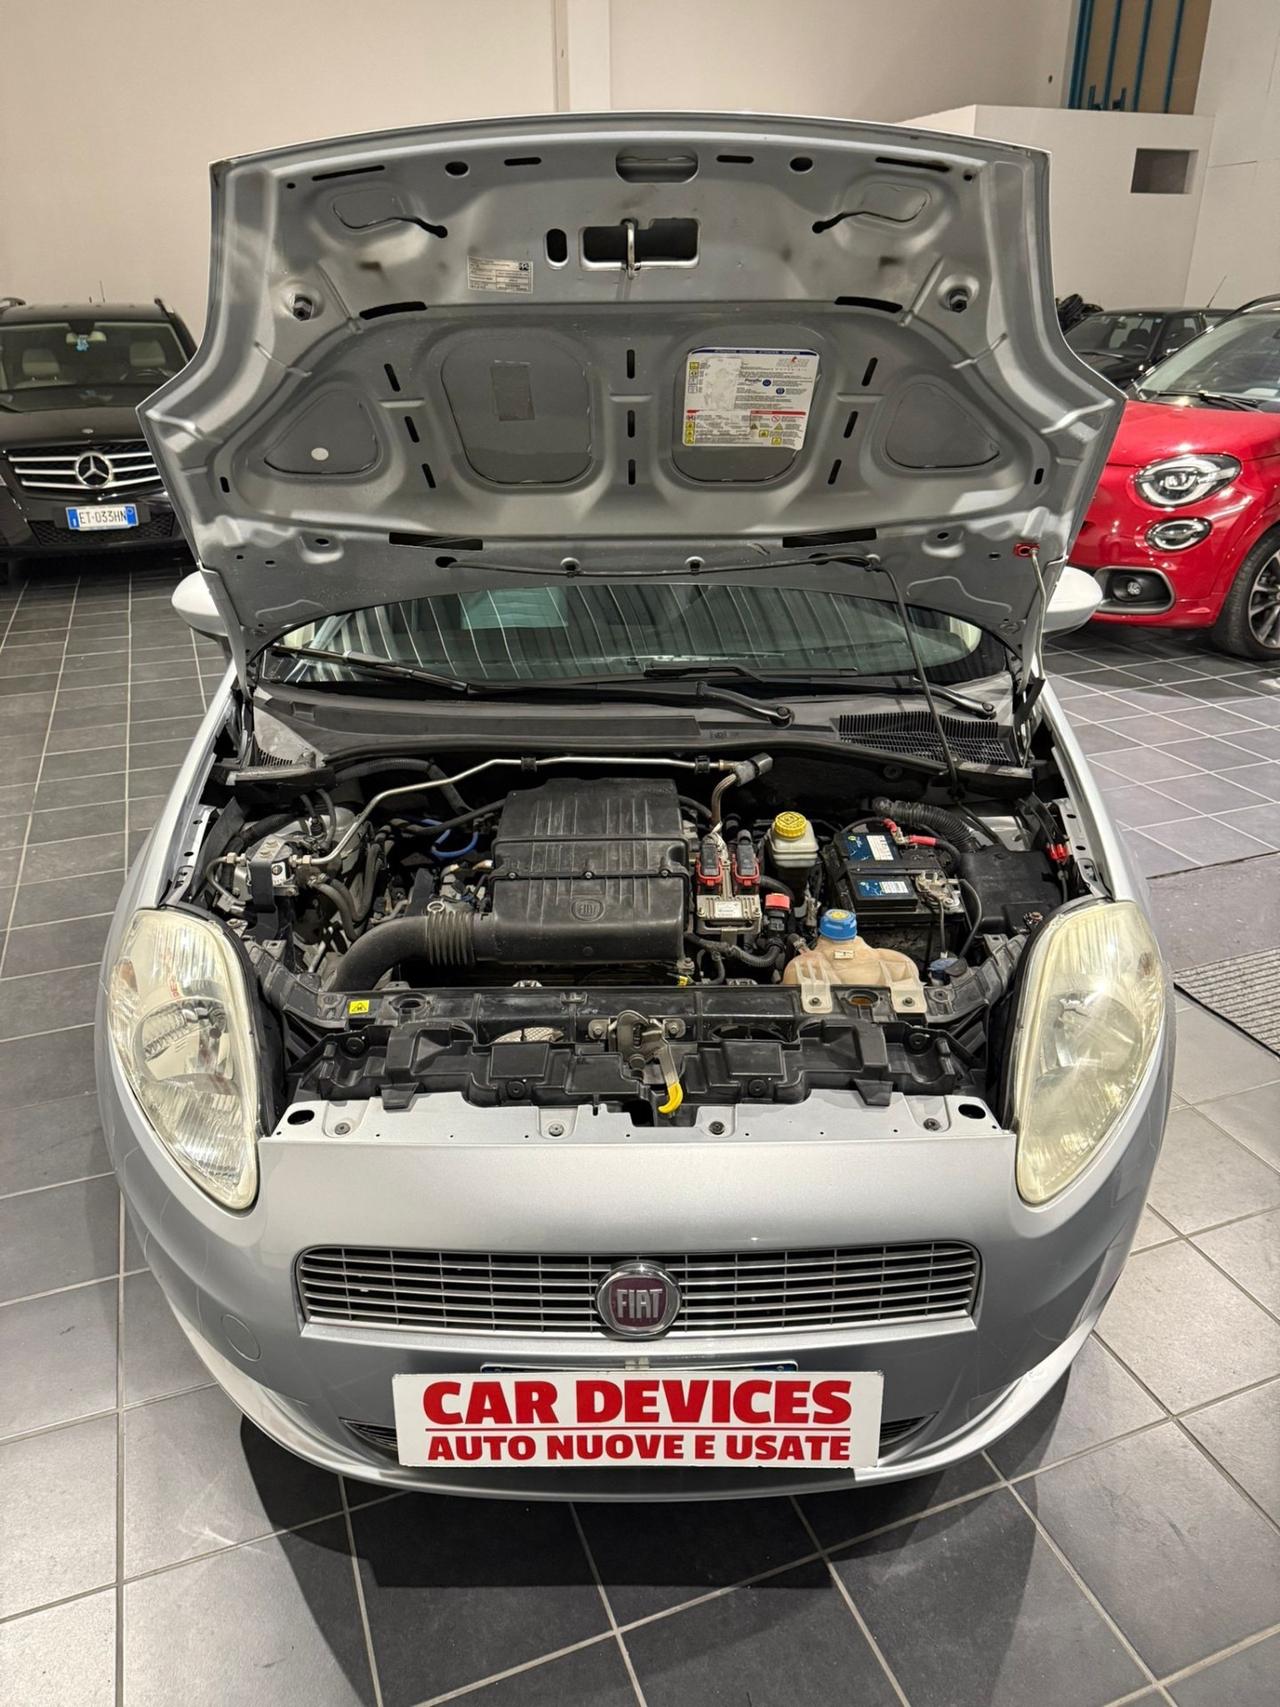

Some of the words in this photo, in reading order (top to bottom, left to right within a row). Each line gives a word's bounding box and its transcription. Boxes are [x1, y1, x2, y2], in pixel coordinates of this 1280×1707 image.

[616, 1288, 663, 1319] FIAT
[422, 1380, 558, 1426] CAR
[575, 1379, 852, 1426] DEVICES
[427, 1435, 537, 1462] AUTO
[546, 1433, 684, 1461] NUOVE
[694, 1434, 715, 1461] E
[725, 1434, 850, 1462] USATE
